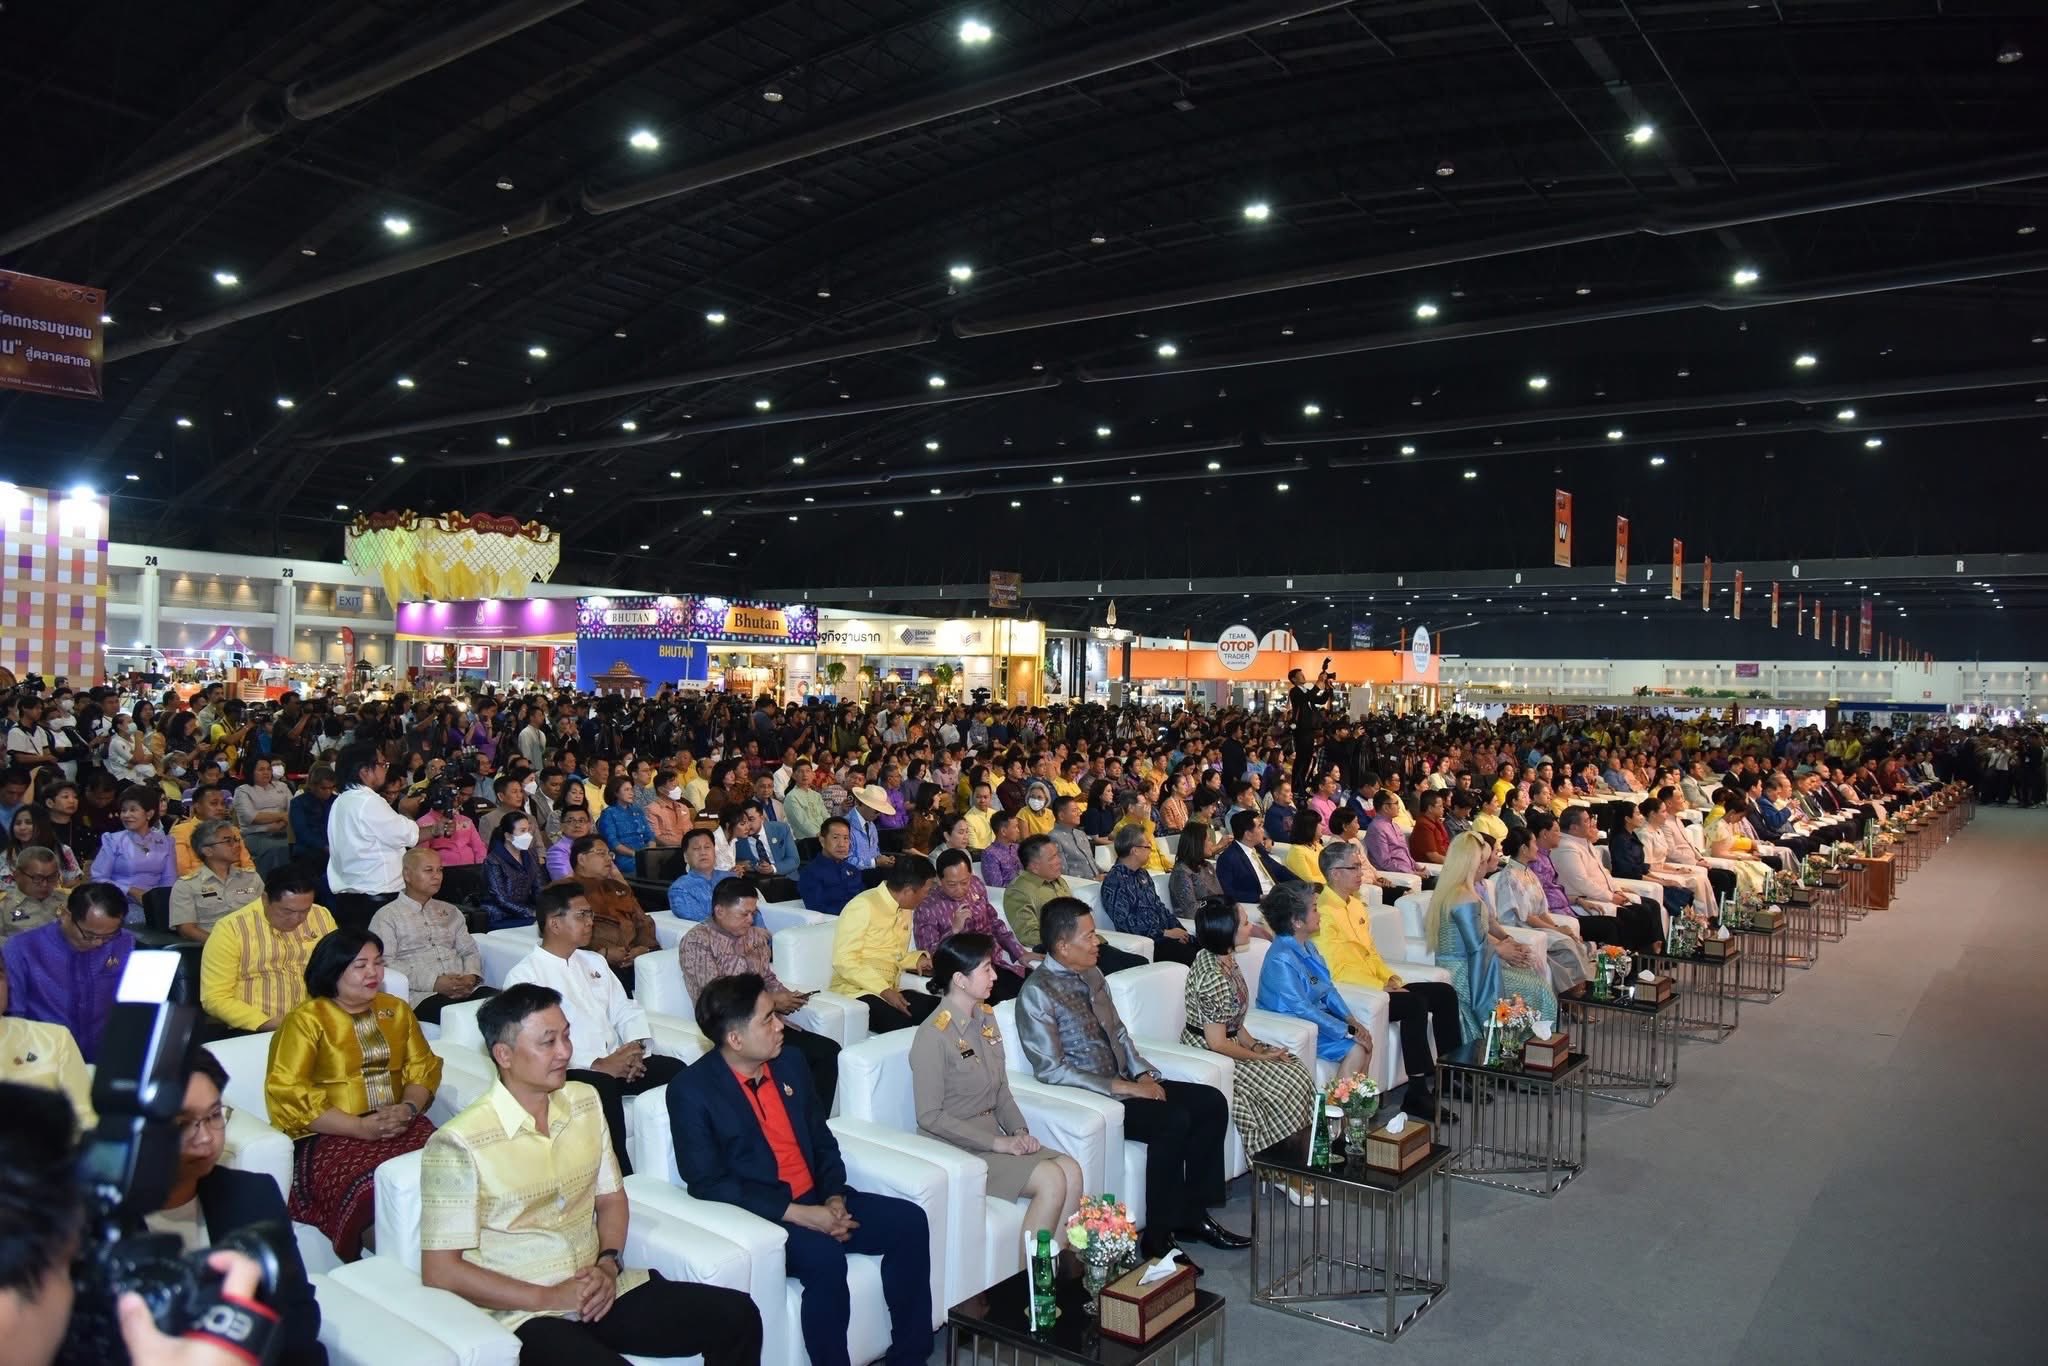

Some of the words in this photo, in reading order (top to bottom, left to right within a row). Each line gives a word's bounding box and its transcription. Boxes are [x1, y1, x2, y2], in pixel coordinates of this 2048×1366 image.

[1559, 522, 1568, 540] W
[145, 556, 158, 567] 24
[1956, 560, 1965, 573] R
[282, 568, 294, 578] 23
[1646, 569, 1654, 581] P
[1791, 564, 1800, 578] Q
[339, 596, 361, 606] EXIT
[612, 610, 650, 623] BHUTAN
[734, 612, 780, 630] Bhutan
[659, 644, 694, 659] BHUTAN
[1219, 640, 1255, 652] OTOP
[192, 1305, 253, 1341] EO
